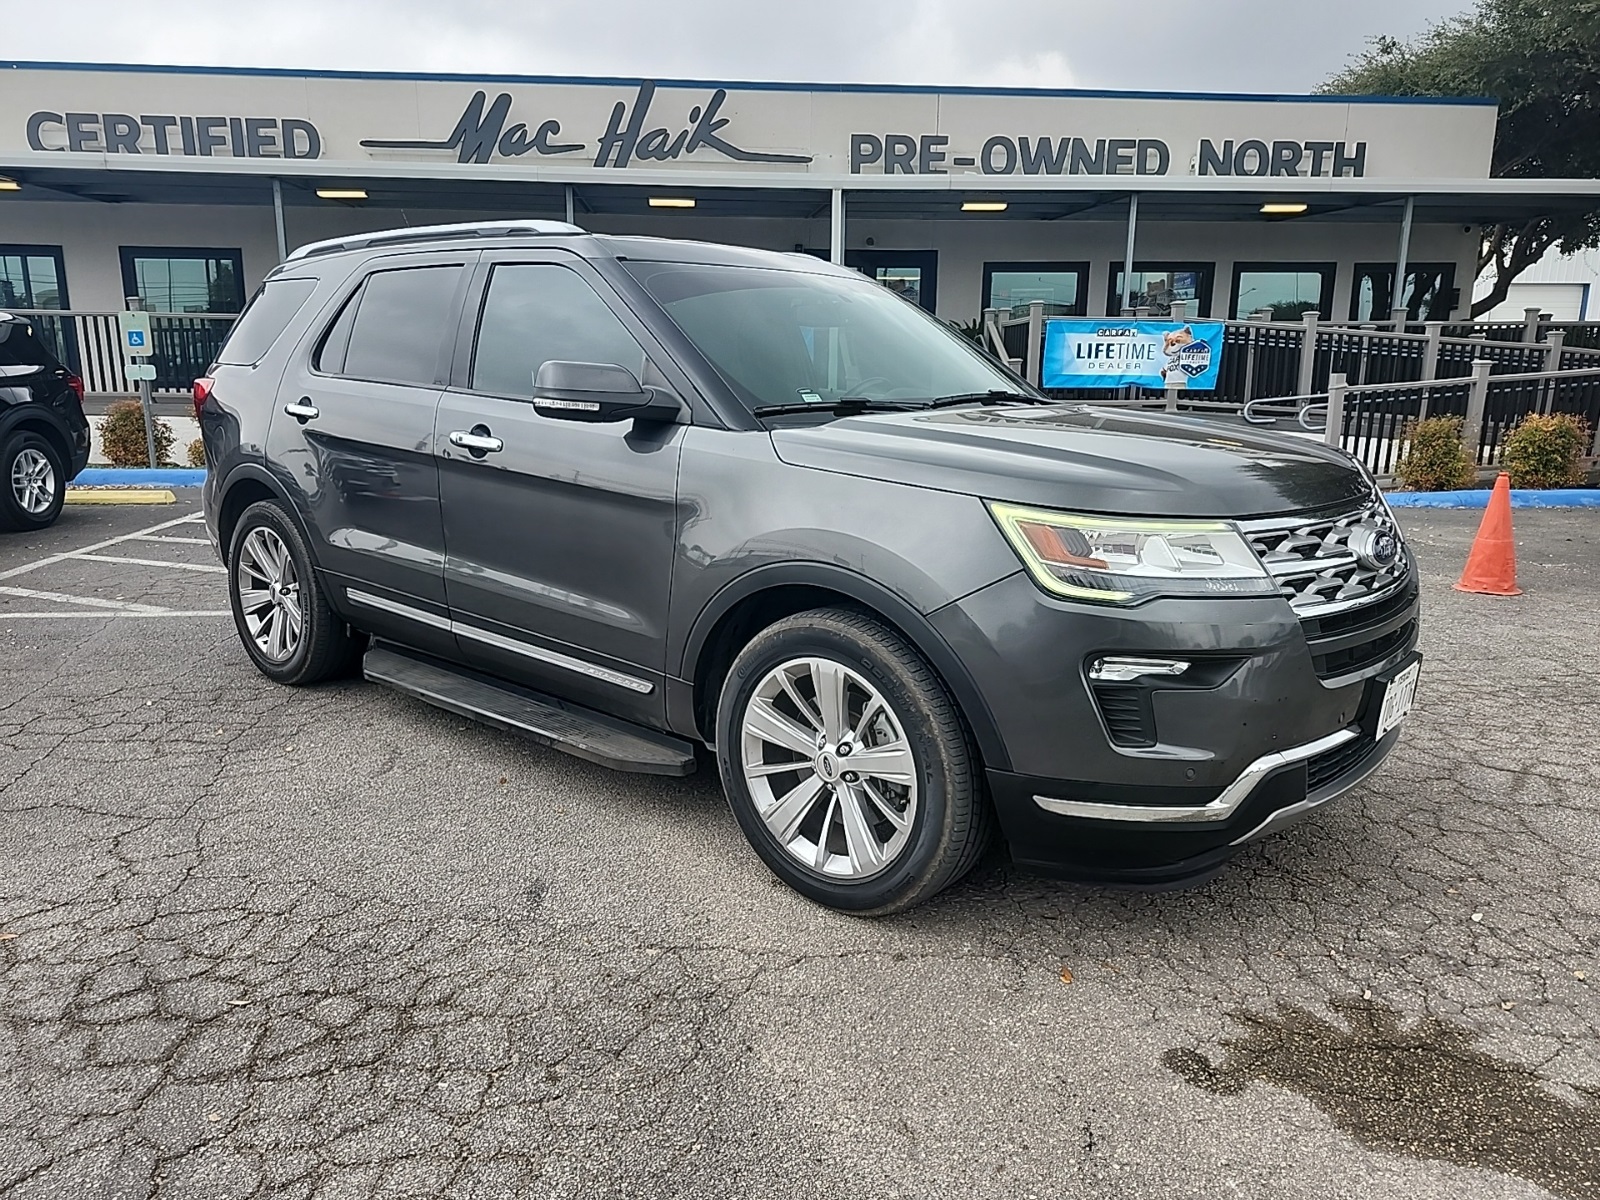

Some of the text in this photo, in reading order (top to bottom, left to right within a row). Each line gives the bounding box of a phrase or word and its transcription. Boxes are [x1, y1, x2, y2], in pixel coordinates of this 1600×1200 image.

[26, 110, 321, 160] CERTIFIED
[360, 79, 813, 168] Mac Haik
[849, 133, 1367, 177] PRE-OWNED NORTH
[1097, 328, 1138, 337] CARFAX
[1076, 342, 1157, 360] LIFETIME
[1180, 353, 1209, 361] LIFETIME
